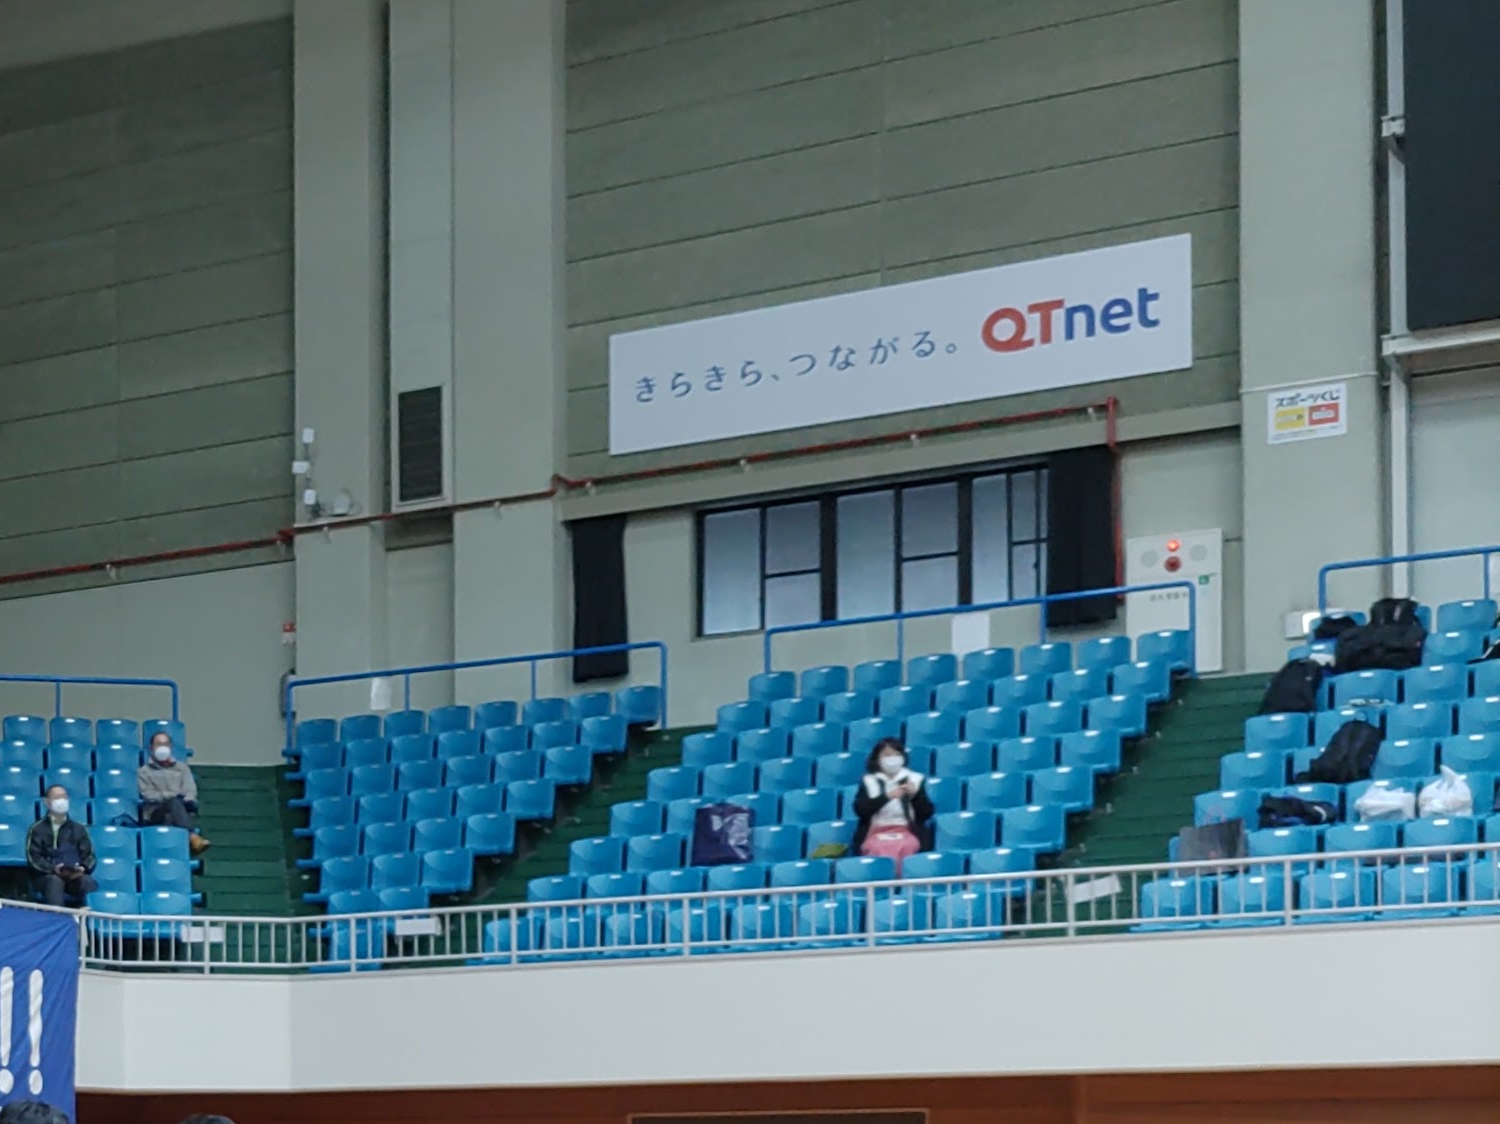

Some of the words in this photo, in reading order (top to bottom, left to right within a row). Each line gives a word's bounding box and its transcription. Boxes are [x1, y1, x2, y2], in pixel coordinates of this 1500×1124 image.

[635, 329, 958, 403] きらきら、つながる。
[980, 287, 1160, 353] QTnet
